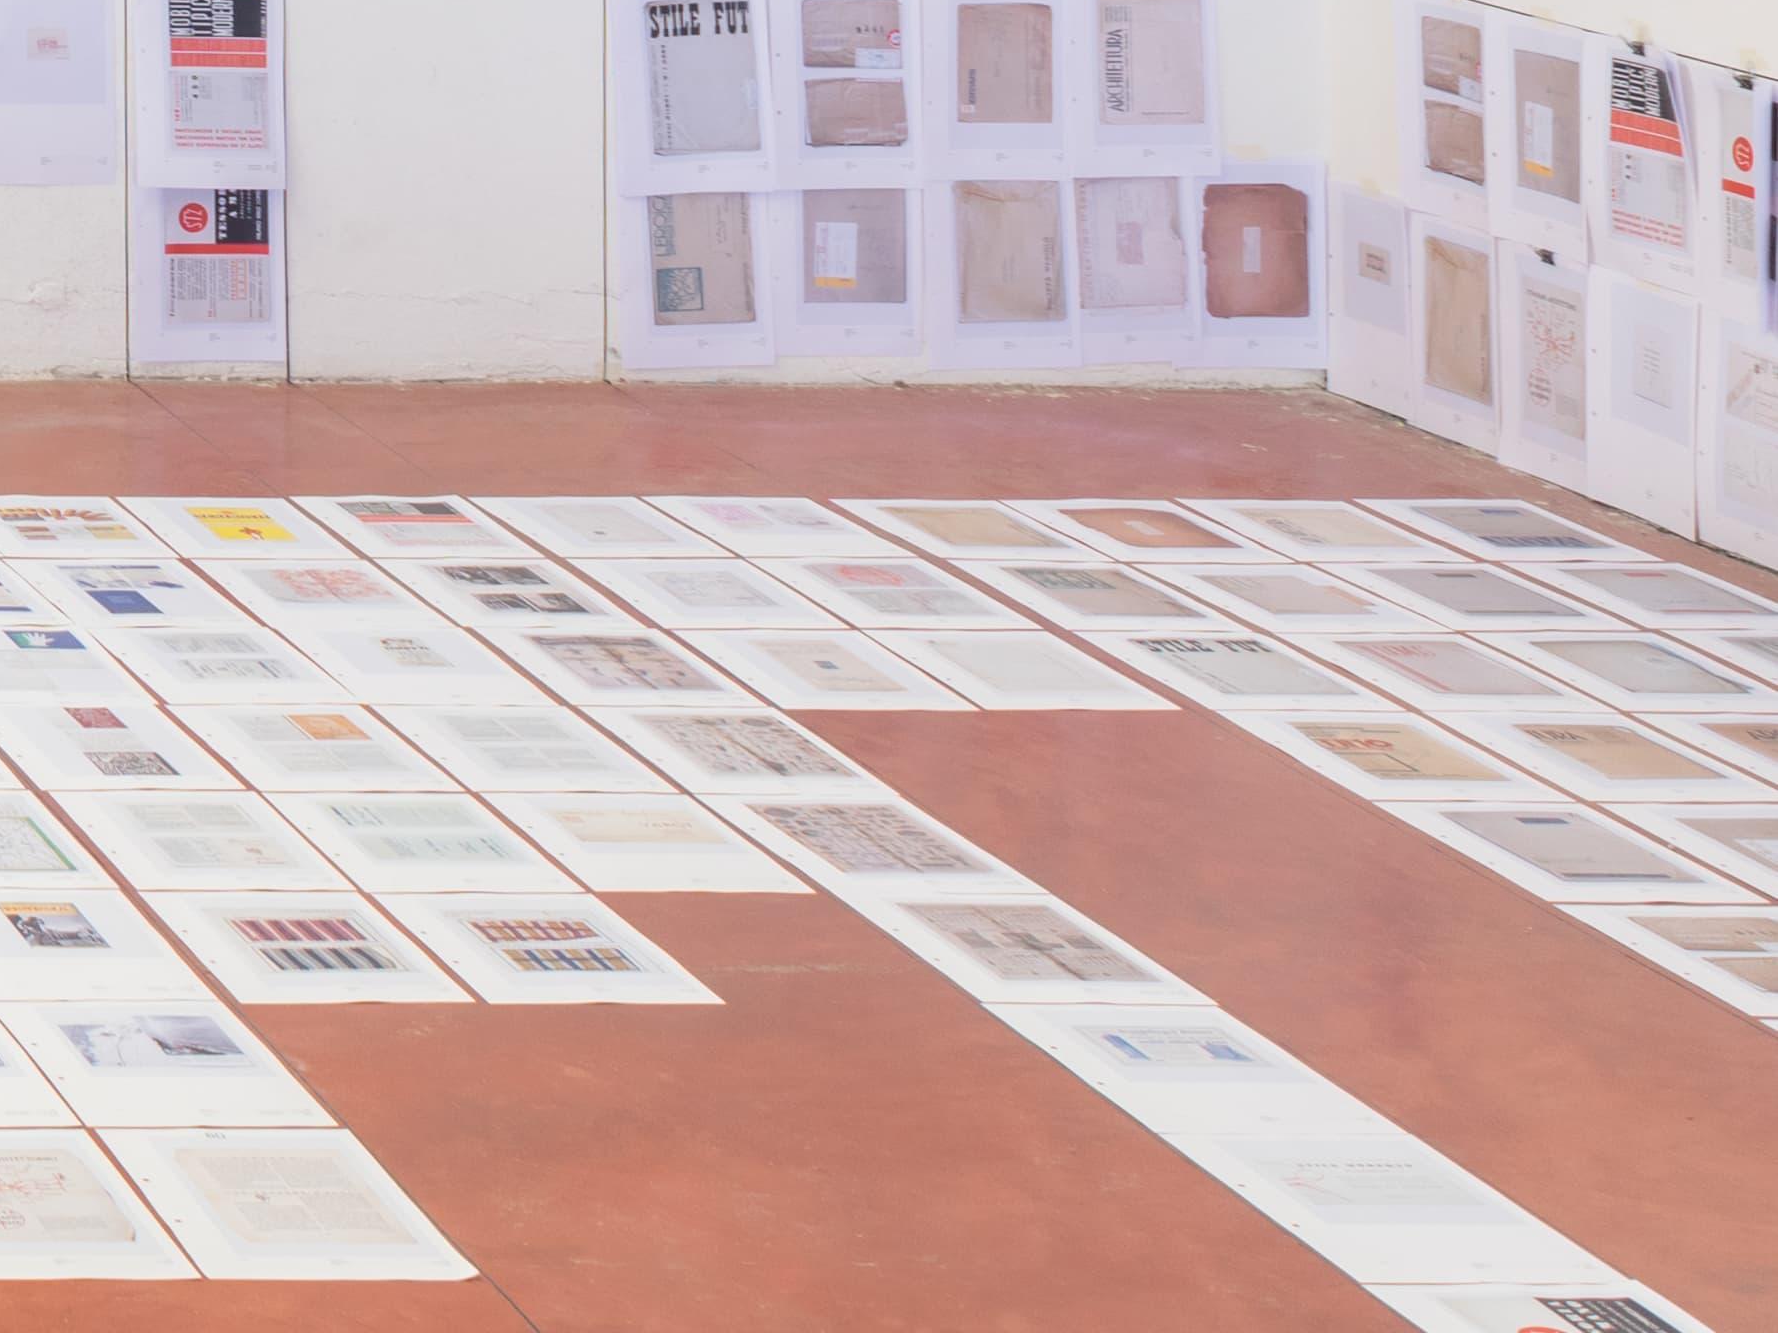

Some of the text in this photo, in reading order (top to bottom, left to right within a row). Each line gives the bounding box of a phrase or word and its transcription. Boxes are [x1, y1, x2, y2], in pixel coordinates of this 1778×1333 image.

[650, 1, 750, 38] STILE FUT
[1106, 28, 1125, 112] ARCHITETTURA
[1135, 639, 1213, 653] STILE
